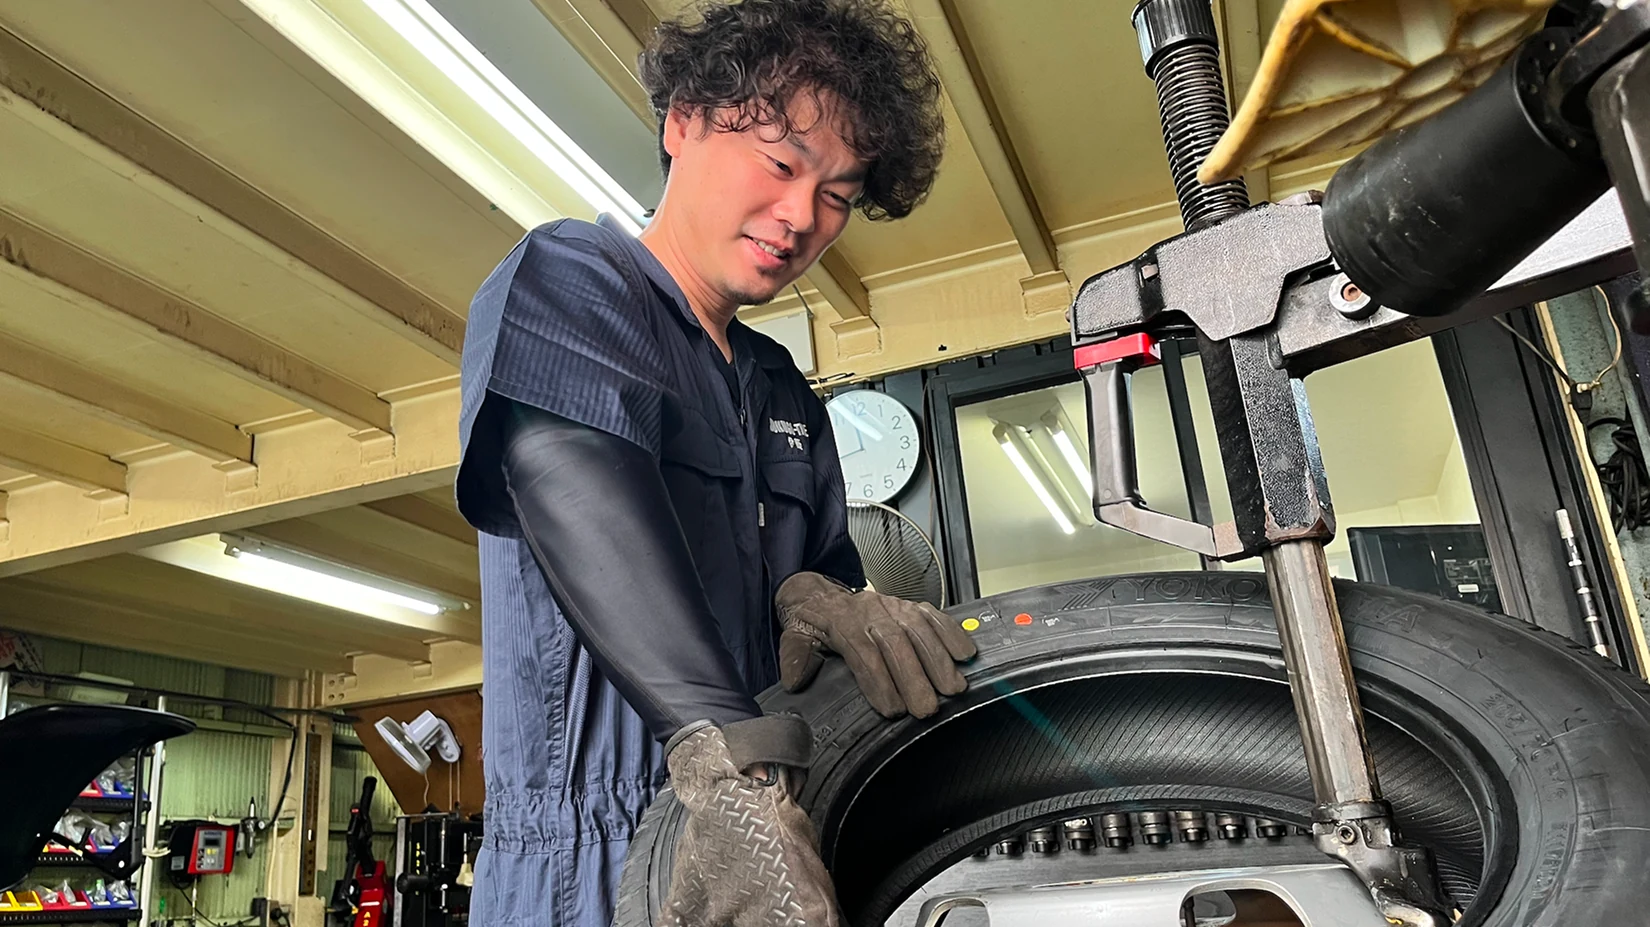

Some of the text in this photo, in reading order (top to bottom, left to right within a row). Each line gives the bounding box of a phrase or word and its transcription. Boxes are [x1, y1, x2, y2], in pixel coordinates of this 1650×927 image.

[852, 401, 867, 416] 12
[891, 415, 902, 430] 2
[900, 435, 911, 450] 3
[896, 457, 907, 471] 4
[845, 482, 852, 495] 7
[883, 474, 894, 489] 5
[863, 484, 874, 498] 6
